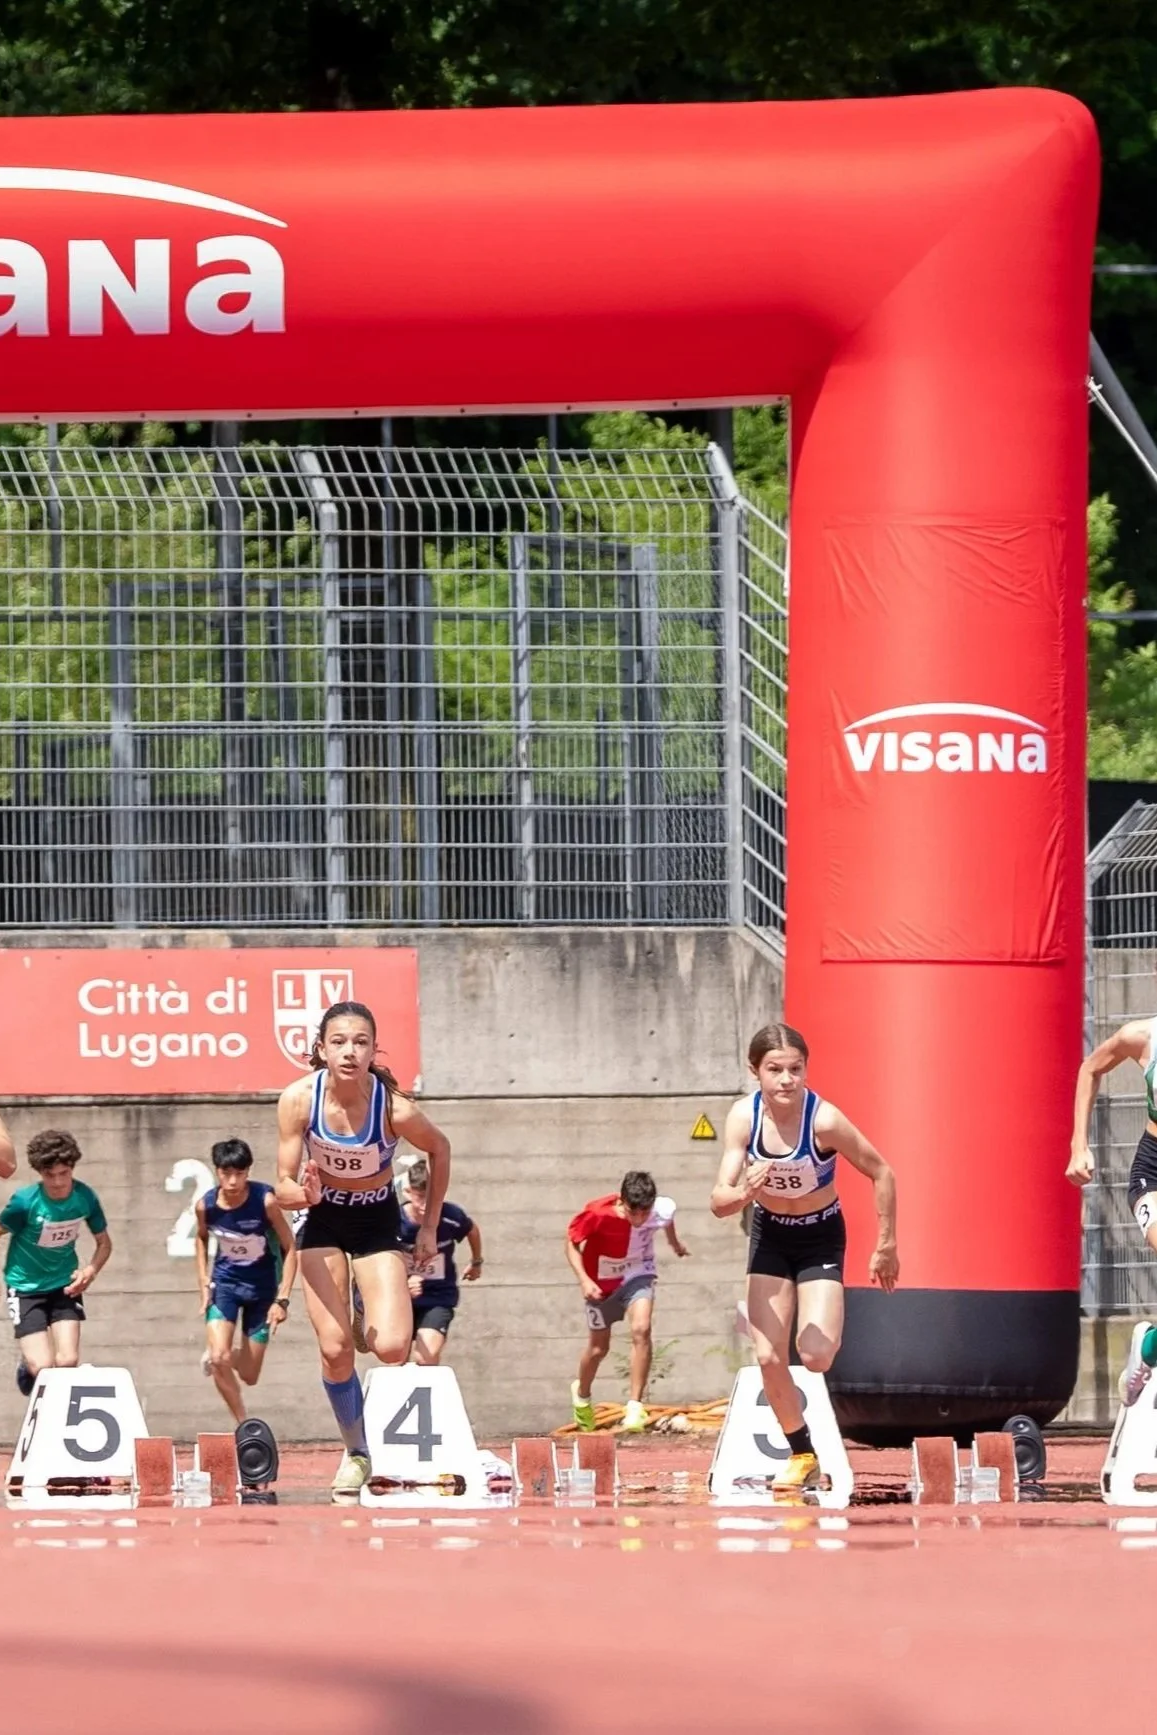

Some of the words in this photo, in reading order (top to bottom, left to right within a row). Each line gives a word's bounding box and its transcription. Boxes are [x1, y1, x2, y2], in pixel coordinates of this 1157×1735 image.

[78, 978, 189, 1015] Città
[205, 976, 248, 1015] di
[78, 1022, 249, 1068] Lugano
[323, 1154, 363, 1171] 198
[764, 1176, 802, 1190] 238
[322, 1186, 348, 1206] KE
[349, 1186, 389, 1206] PRO
[165, 1159, 218, 1257] 2
[770, 1214, 820, 1226] NIKE
[52, 1229, 73, 1241] 125
[588, 1309, 601, 1327] 2
[63, 1385, 121, 1462] 5
[383, 1387, 443, 1462] 4
